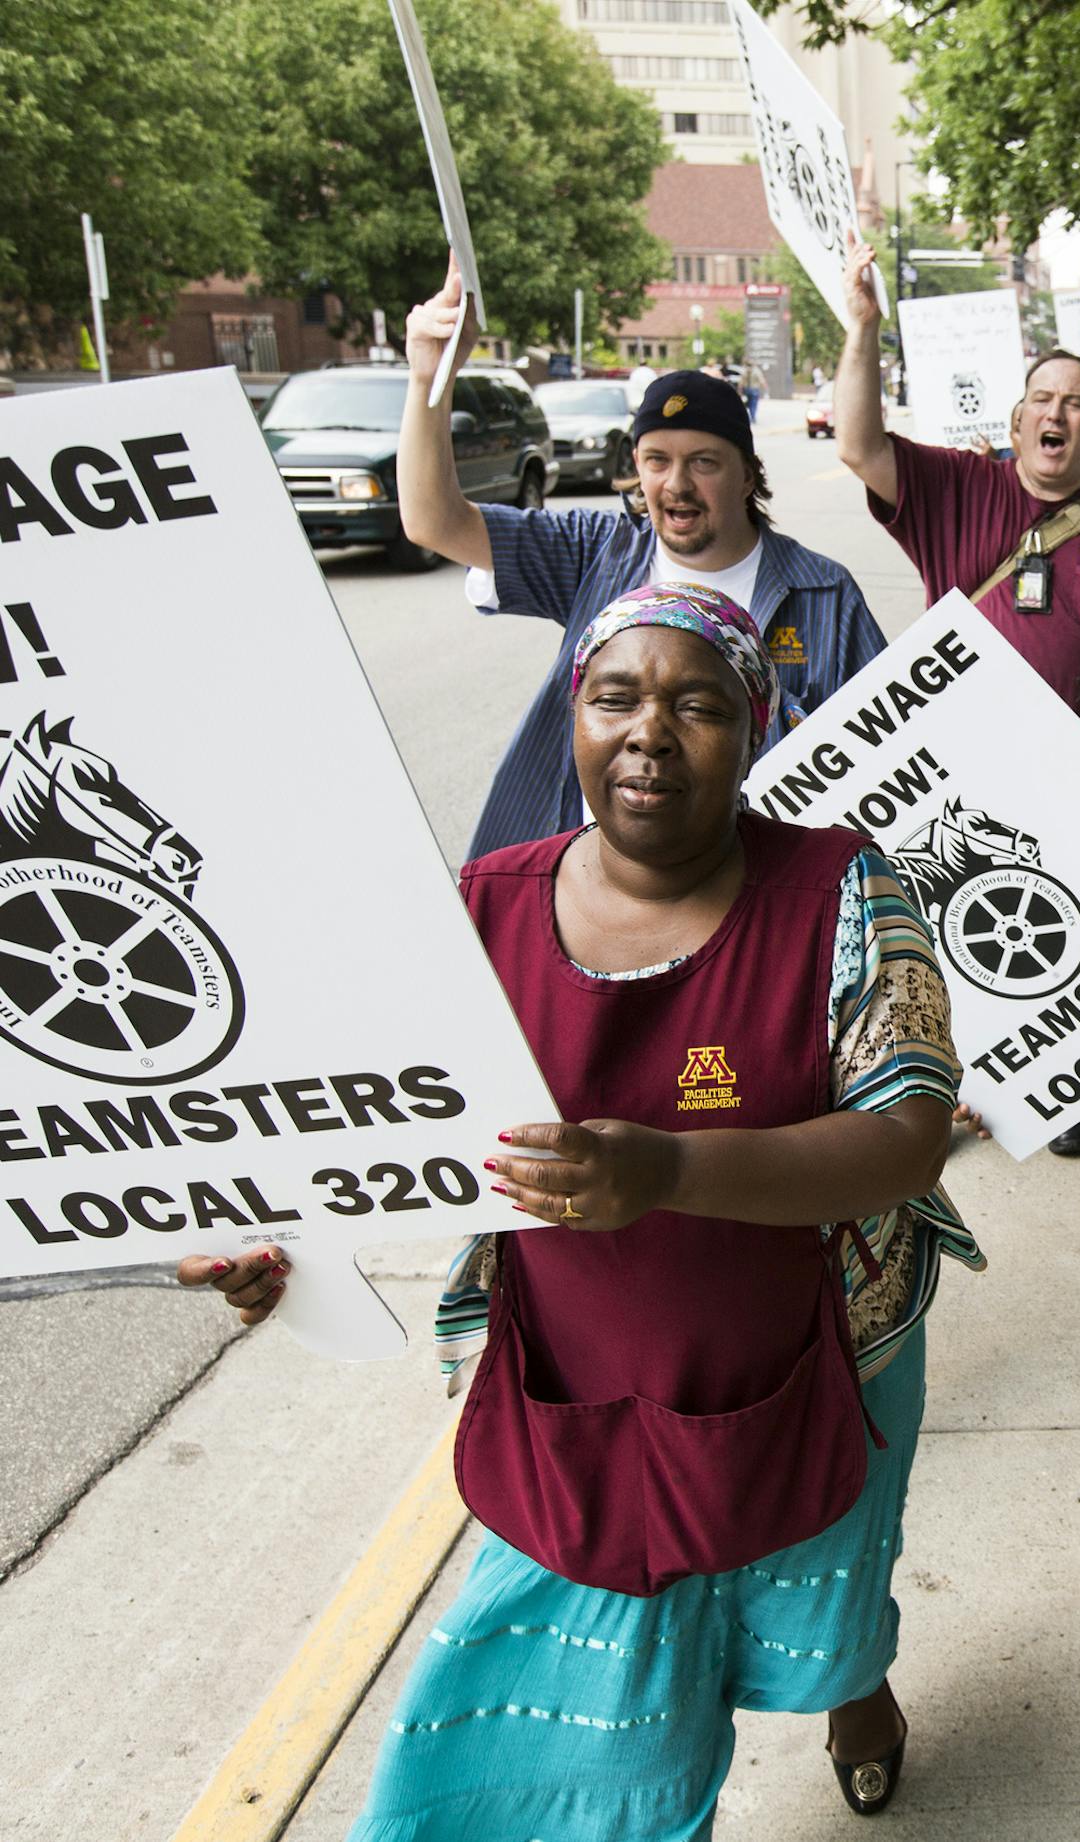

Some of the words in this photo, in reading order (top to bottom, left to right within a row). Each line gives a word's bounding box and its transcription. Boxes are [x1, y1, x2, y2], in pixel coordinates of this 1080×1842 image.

[842, 629, 980, 748] WAGE
[949, 873, 1011, 917] Brotherhood
[1016, 875, 1029, 884] of
[1033, 878, 1077, 928] Teamsters
[131, 894, 160, 912] of
[161, 909, 221, 1011] Teamsters
[948, 921, 997, 986] International
[677, 1046, 737, 1087] M
[677, 1097, 742, 1112] MANAGEMENT
[683, 1086, 733, 1100] FACILITIES
[9, 1176, 303, 1245] LOCAL
[311, 1156, 481, 1217] 320
